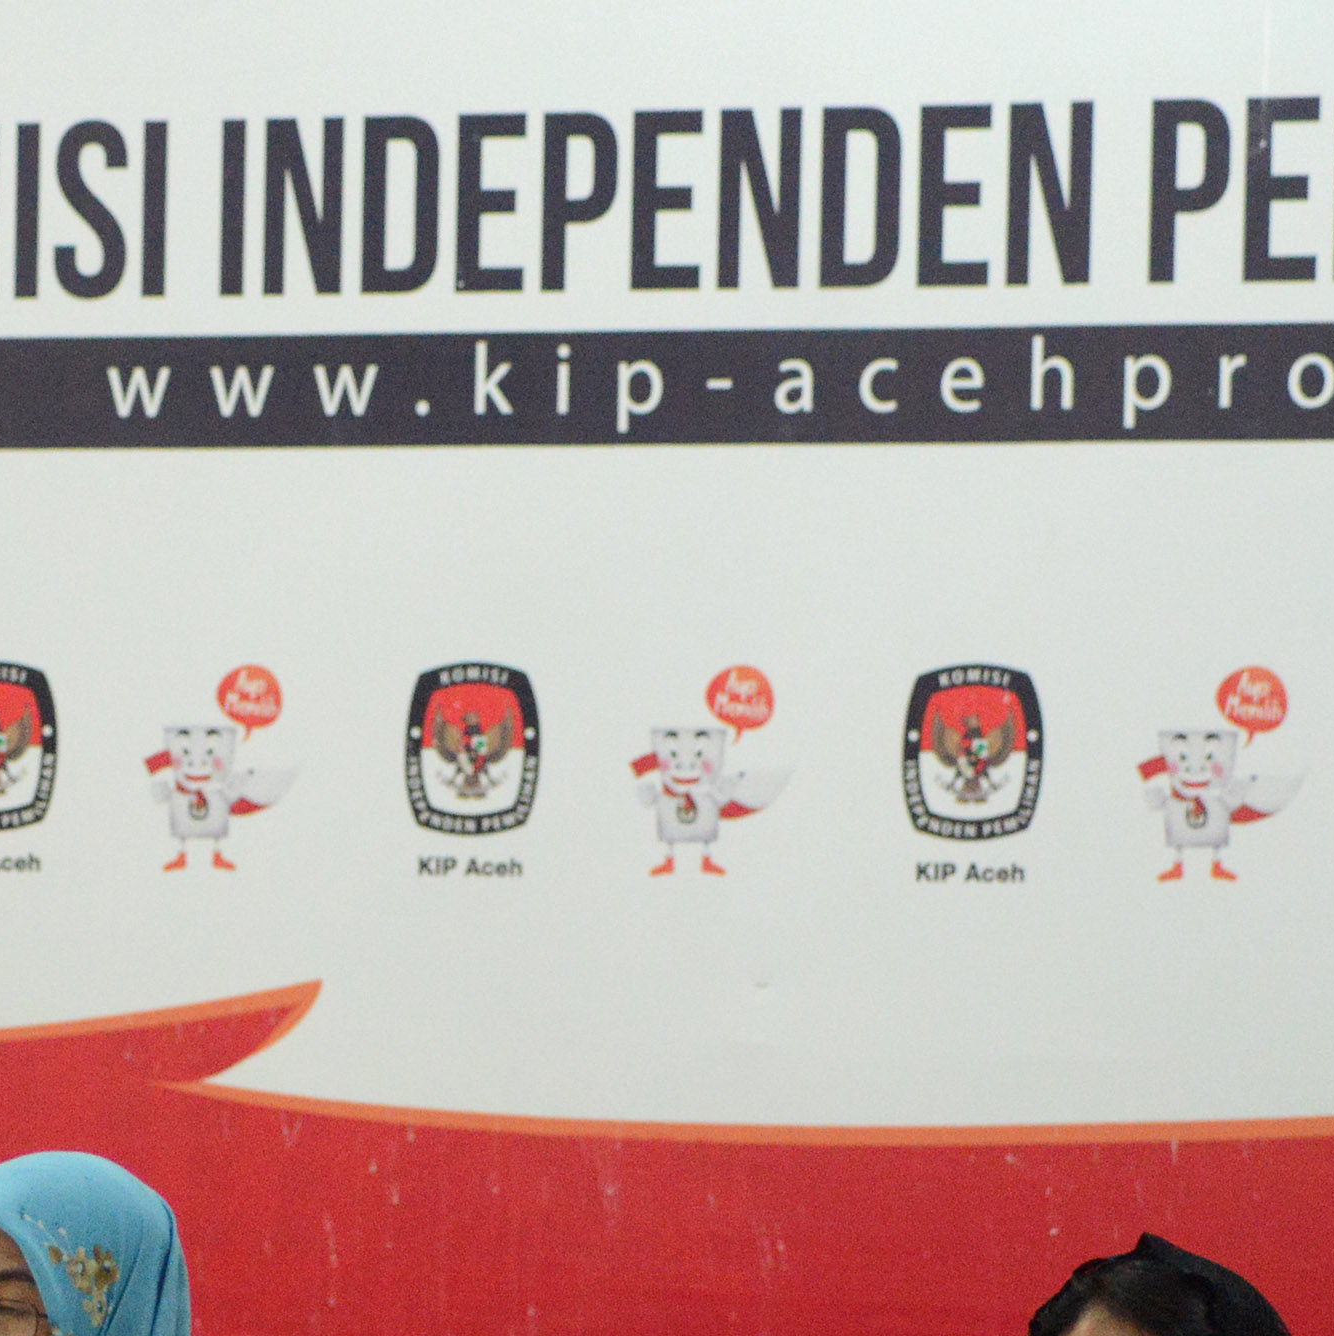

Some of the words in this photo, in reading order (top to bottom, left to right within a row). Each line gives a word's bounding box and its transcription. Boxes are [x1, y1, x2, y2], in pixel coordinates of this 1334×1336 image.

[219, 101, 1094, 297] INDEPENDEN
[936, 668, 1010, 687] KOMISI
[419, 858, 457, 875] KIP
[466, 858, 522, 876] Aceh
[916, 862, 956, 881] KIP
[965, 863, 1025, 882] Aceh
